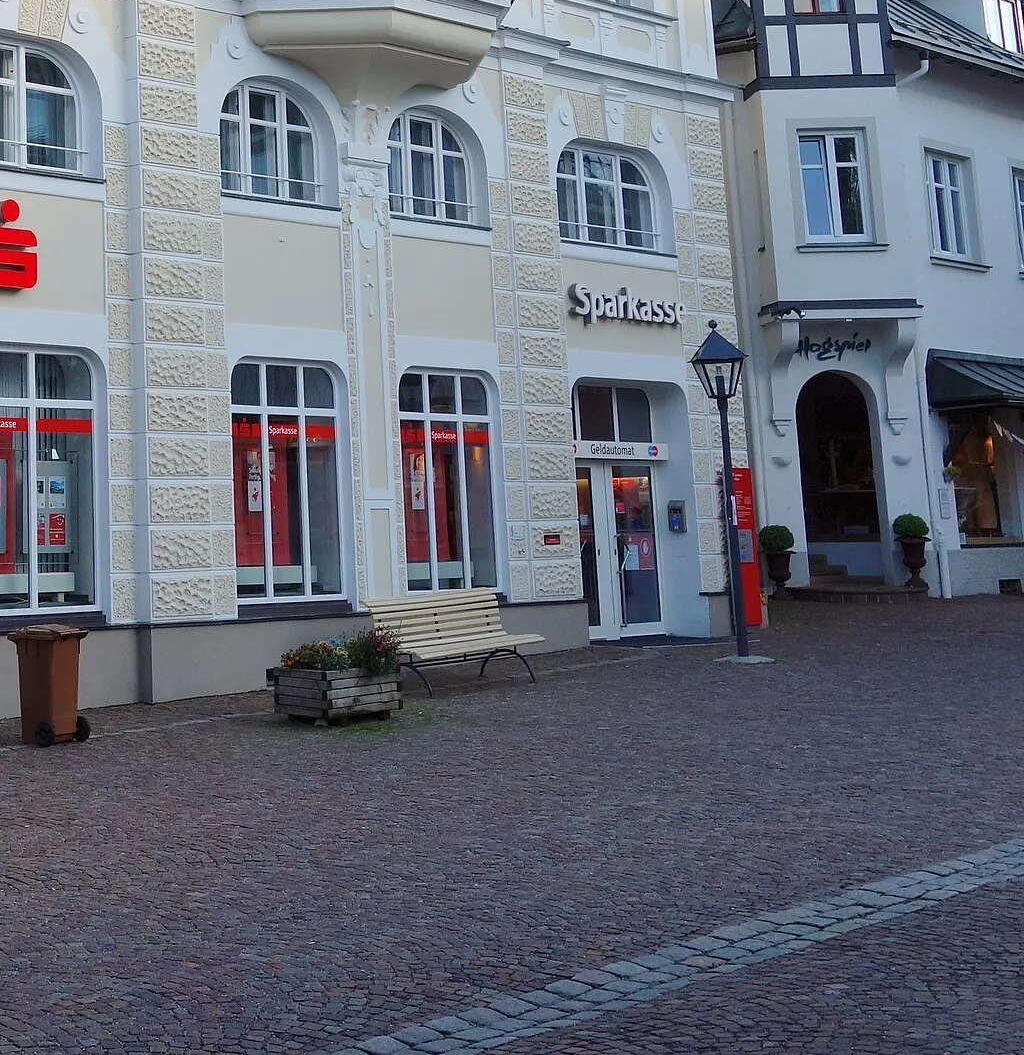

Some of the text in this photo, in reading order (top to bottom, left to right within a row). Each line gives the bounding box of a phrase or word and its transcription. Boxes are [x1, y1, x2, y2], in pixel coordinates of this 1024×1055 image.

[568, 283, 687, 325] Sparkasse
[268, 426, 298, 436] Sparkasse
[431, 431, 457, 441] Sparkasse
[590, 443, 635, 456] Geldautomat
